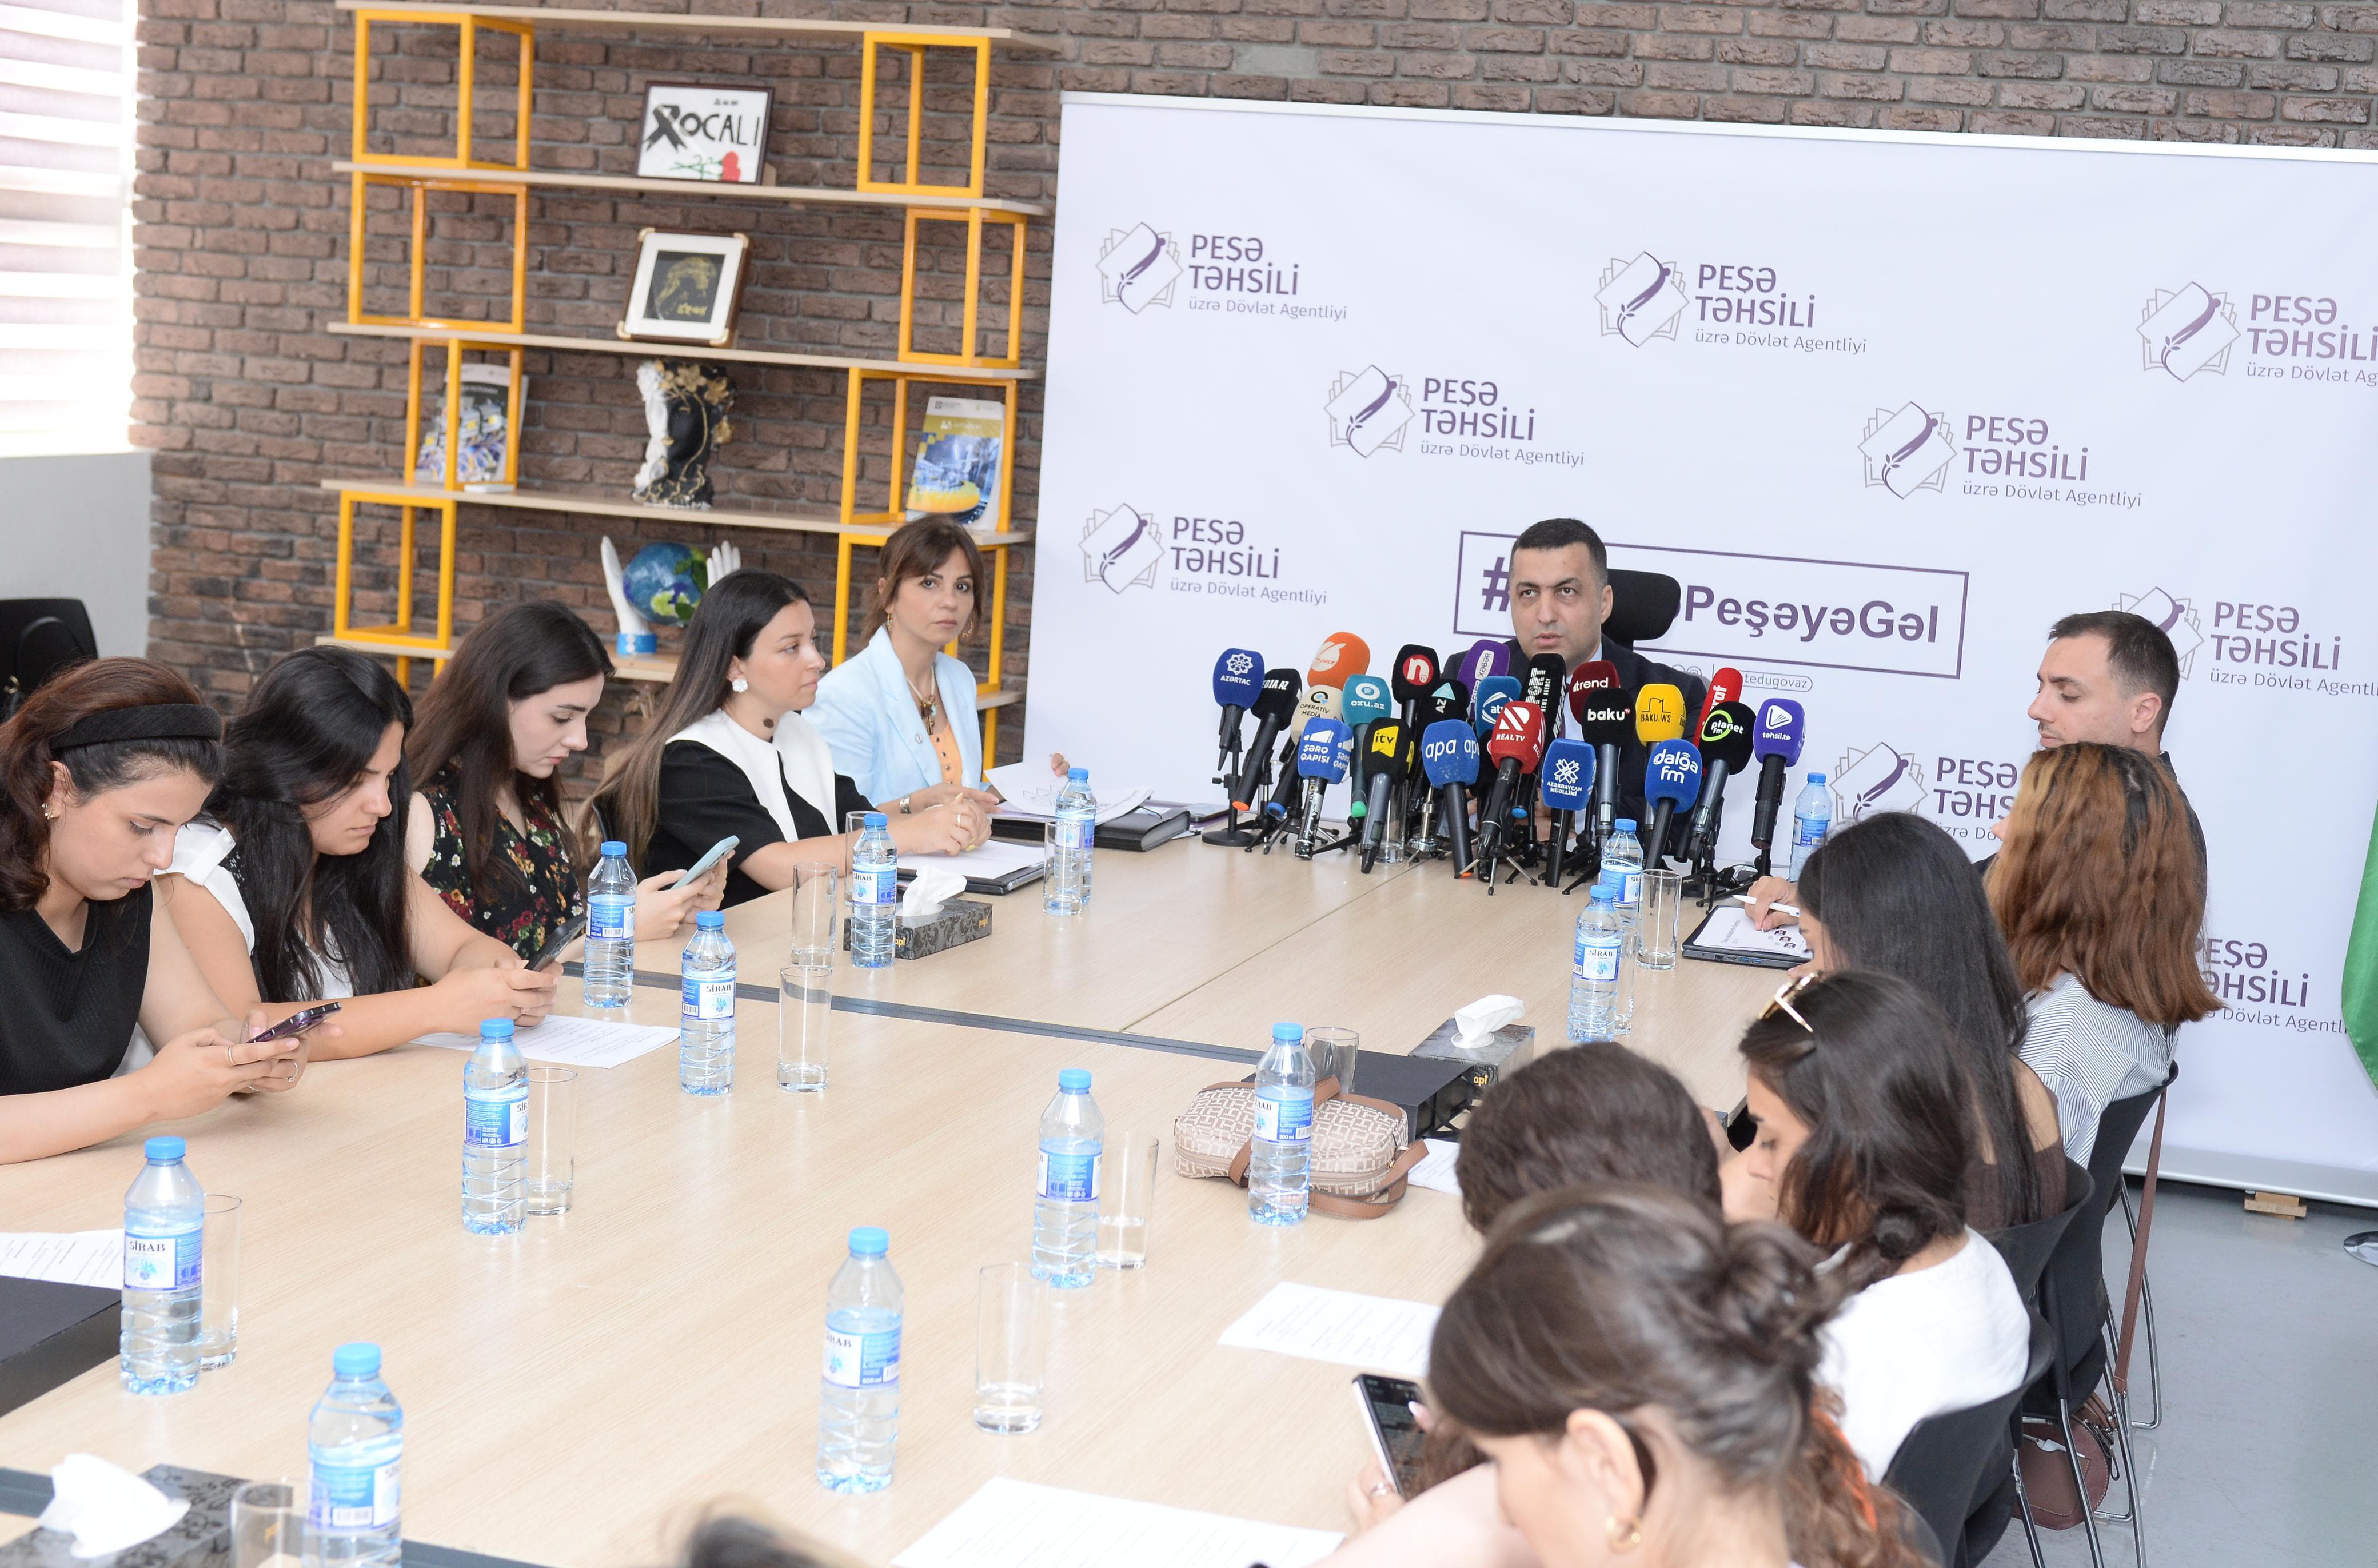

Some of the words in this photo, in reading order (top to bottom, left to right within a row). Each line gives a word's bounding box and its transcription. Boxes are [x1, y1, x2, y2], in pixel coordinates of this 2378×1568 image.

[1191, 234, 1263, 263] PEŞƏ
[1189, 264, 1299, 296] TƏHSİLİ
[1698, 264, 1777, 293] PEŞƏ
[1188, 297, 1220, 313] üzrə
[1226, 297, 1275, 316] Dövlət
[1280, 302, 1347, 322] Agentliyi
[1695, 292, 1816, 328] TƏHSİLİ
[2251, 294, 2338, 326] PEŞƏ
[1695, 329, 1729, 344] üzrə
[1736, 332, 1789, 348] Dövlət
[1794, 336, 1866, 355] Agentliyi
[2247, 324, 2378, 361] TƏHSİLİ
[2247, 362, 2284, 377] üzrə
[2291, 363, 2350, 383] Dövlət
[1423, 378, 1498, 408] PEŞƏ
[1421, 408, 1535, 441] TƏHSİLİ
[1966, 415, 2048, 446] PEŞƏ
[1421, 441, 1454, 456] üzrə
[1459, 441, 1510, 460] Dövlət
[1515, 448, 1585, 468] Agentliyi
[1963, 446, 2089, 481] TƏHSİLİ
[1963, 482, 1998, 497] üzrə
[2005, 483, 2060, 501] Dövlət
[2066, 489, 2142, 509] Agentliyi
[1173, 517, 1244, 545] PEŞƏ
[1170, 545, 1280, 579] TƏHSİLİ
[1170, 578, 1202, 593] üzrə
[1207, 579, 1256, 598] Dövlət
[1261, 585, 1327, 605] Agentliyi
[1681, 585, 1938, 643] PeşəyəGəl
[2214, 601, 2299, 633] PEŞƏ
[1478, 652, 1491, 677] XƏBƏR
[2211, 634, 2341, 671] TƏHSİLİ
[1220, 676, 1251, 686] AZƏRTAC
[1525, 668, 1546, 704] PORT
[1745, 673, 1808, 689] tedugovaz
[2211, 668, 2247, 684] üzrə
[2254, 670, 2312, 691] Dövlət
[2317, 679, 2378, 696] Agentl
[1300, 704, 1330, 714] OPERATİV
[1351, 700, 1385, 710] oxu.az
[1587, 708, 1625, 721] baku
[1641, 713, 1671, 723] BAKU.WS
[1375, 732, 1394, 744] itv
[1711, 720, 1745, 735] planet
[1300, 753, 1330, 764] QAPISI
[1304, 744, 1329, 755] ŞƏRQ
[1425, 739, 1457, 762] apa
[1653, 748, 1698, 774] dalğa
[1547, 781, 1583, 792] AZƏRBAYCAN
[1661, 767, 1685, 784] fm
[1937, 757, 2018, 789] PEŞƏ
[1550, 787, 1577, 797] MÜƏLLİMİ
[1933, 789, 2016, 820] TƏHS
[895, 937, 906, 947] api
[2197, 937, 2267, 968] EŞƏ
[2200, 970, 2309, 1007] ƏHSİLİ
[2223, 1007, 2280, 1026] Dövlət
[1474, 1075, 1489, 1086] api
